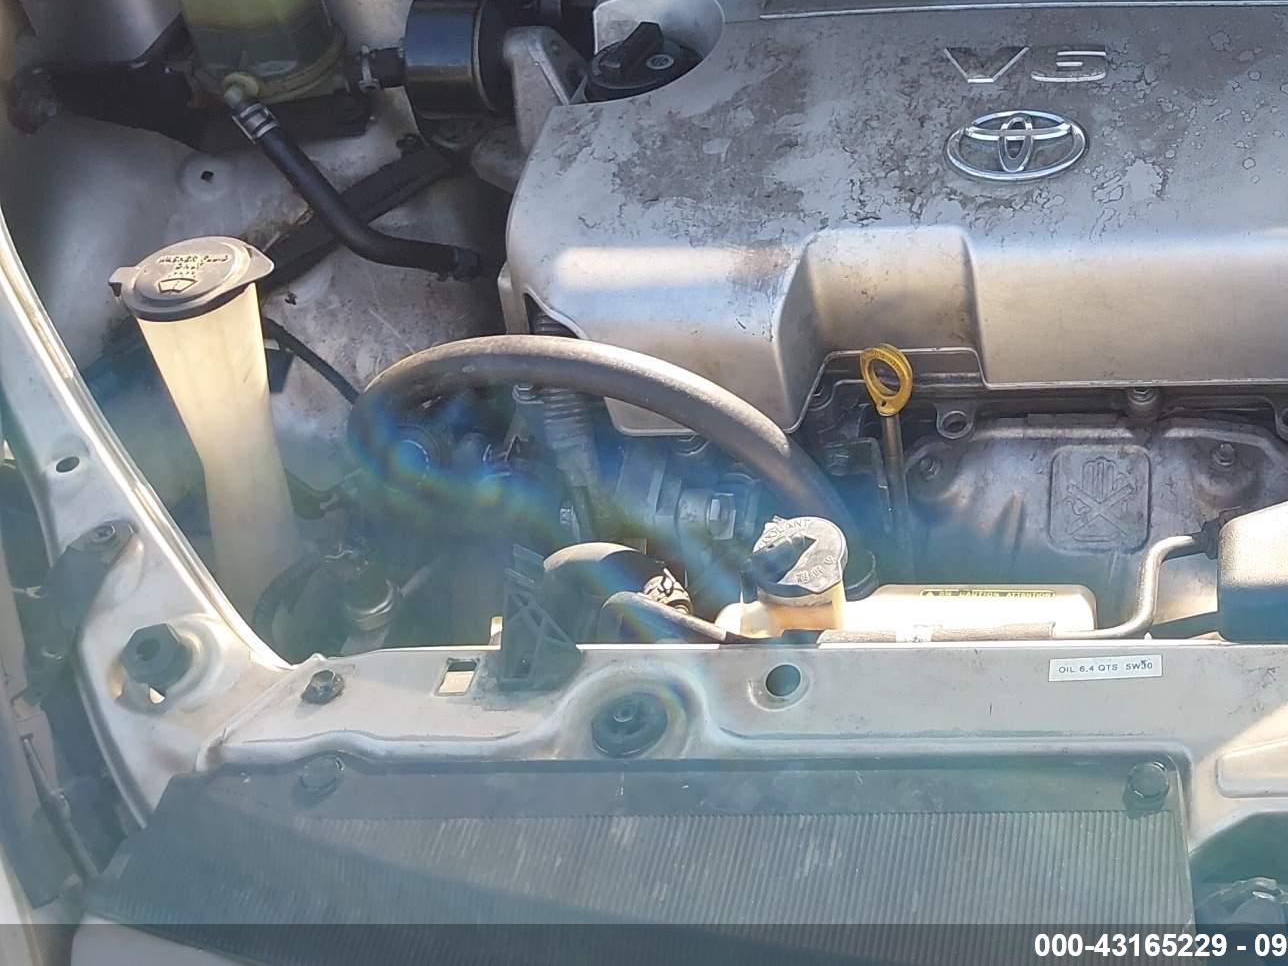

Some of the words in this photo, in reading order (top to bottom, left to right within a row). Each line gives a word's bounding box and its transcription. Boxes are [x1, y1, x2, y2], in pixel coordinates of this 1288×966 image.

[1057, 665, 1076, 674] OIL
[1078, 664, 1095, 674] 6.4
[1097, 663, 1119, 672] QTS
[1124, 659, 1153, 672] 5W30
